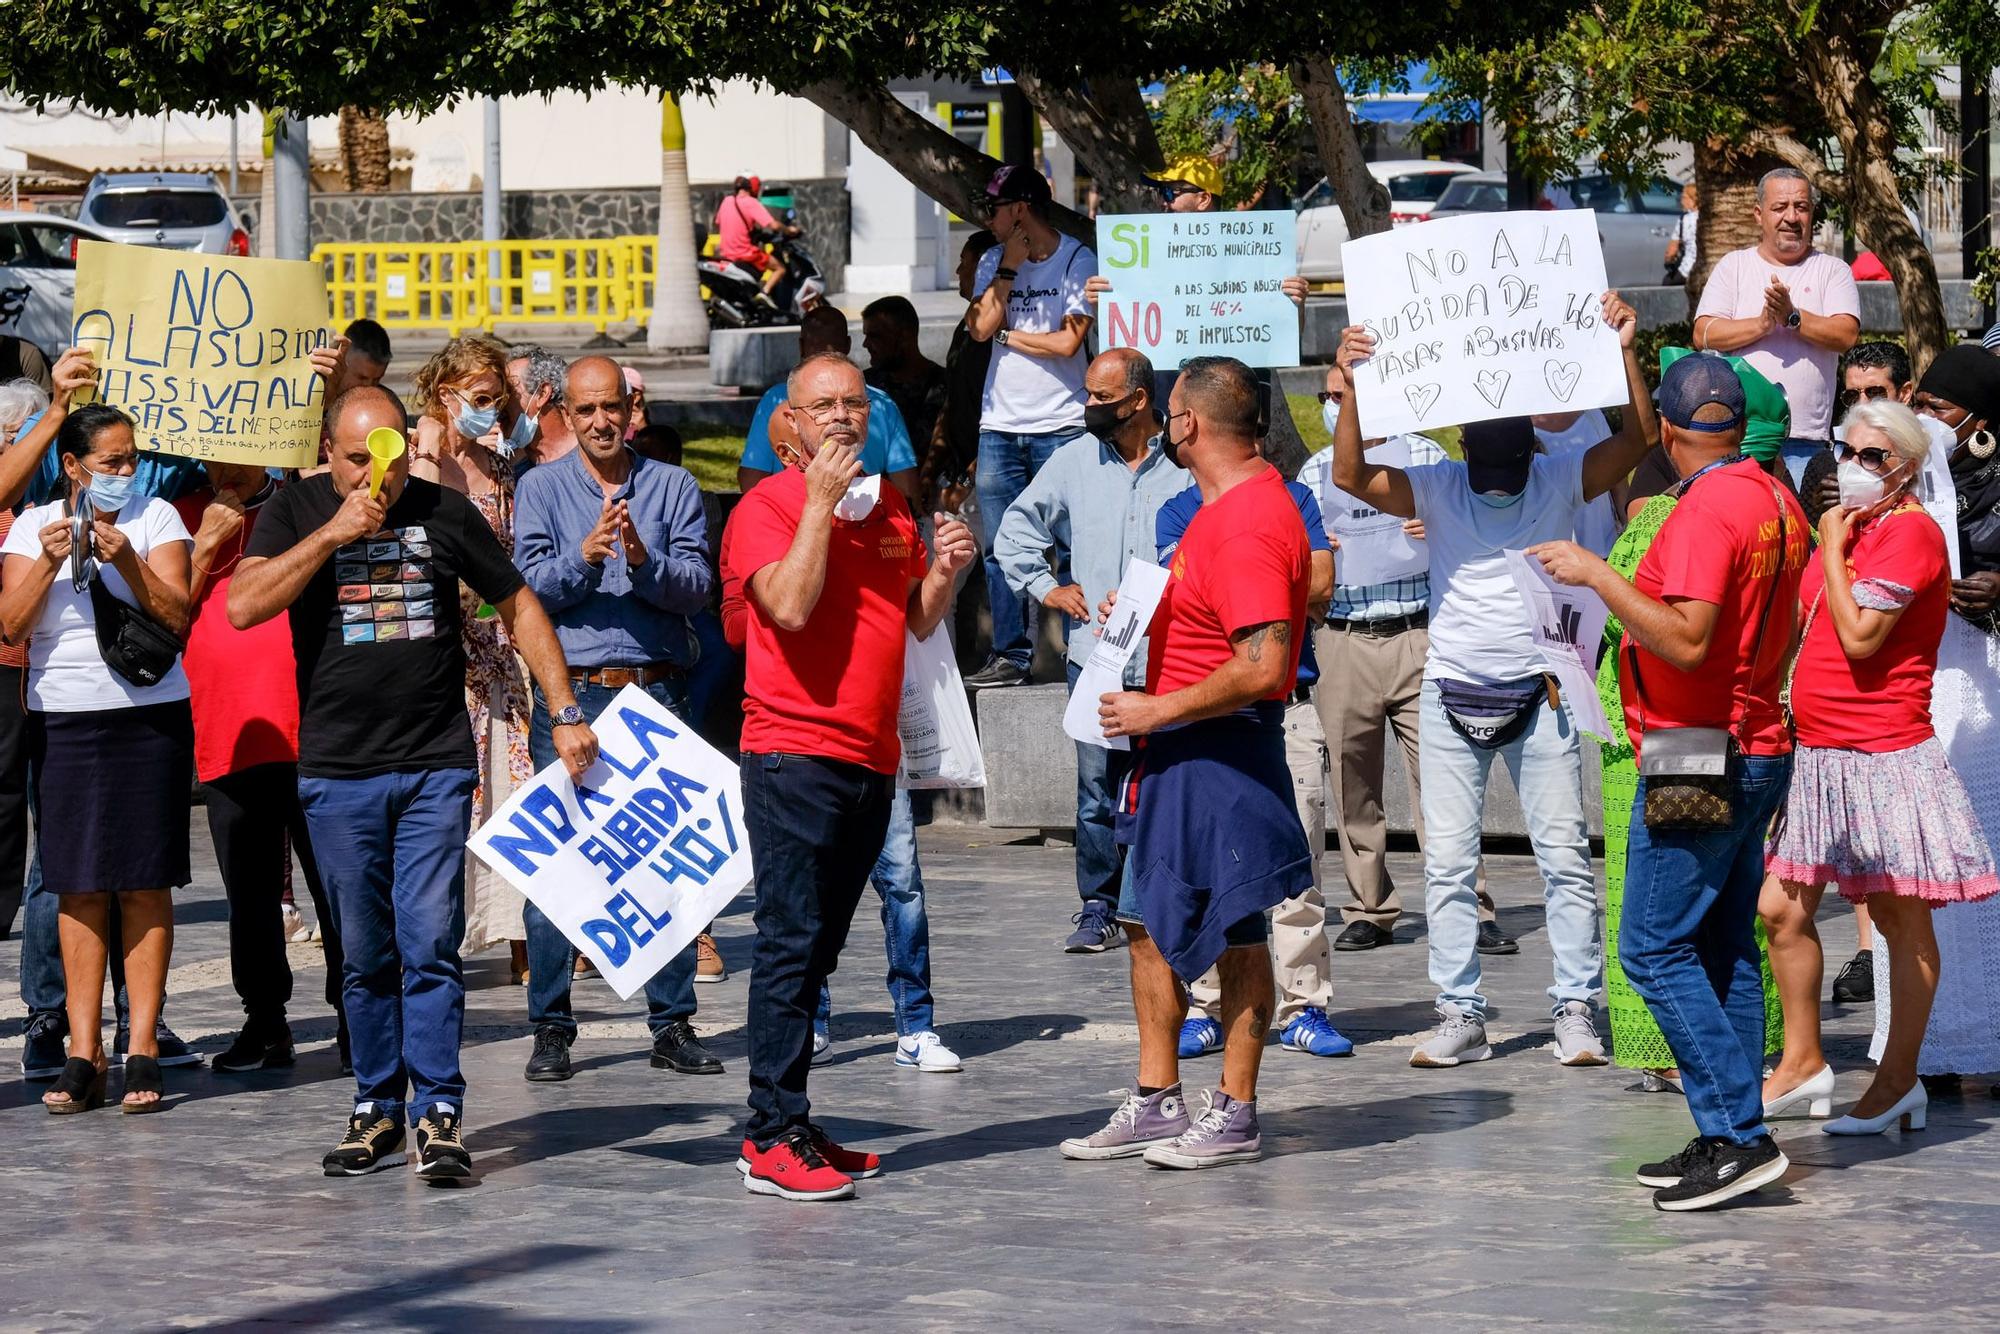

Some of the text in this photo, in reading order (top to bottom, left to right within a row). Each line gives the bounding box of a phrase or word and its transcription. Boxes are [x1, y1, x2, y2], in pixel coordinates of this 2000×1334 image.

[1106, 222, 1151, 270] Si
[1173, 221, 1275, 236] A LOS PAGOS DE
[1406, 224, 1573, 294] NO A LA
[168, 266, 254, 331] NO
[1174, 285, 1181, 296] A
[1185, 283, 1203, 296] LAS
[1185, 301, 1243, 317] DEL 46%
[1498, 274, 1539, 318] DE
[1107, 301, 1162, 348] NO
[1176, 329, 1189, 345] DE
[1368, 340, 1444, 385] TASAS
[198, 409, 237, 434] DEL
[241, 414, 322, 436] MERCADILLO
[268, 439, 311, 450] MOGAN
[486, 783, 578, 878] NO
[577, 766, 709, 887] SUBIDA
[580, 887, 673, 970] DEL
